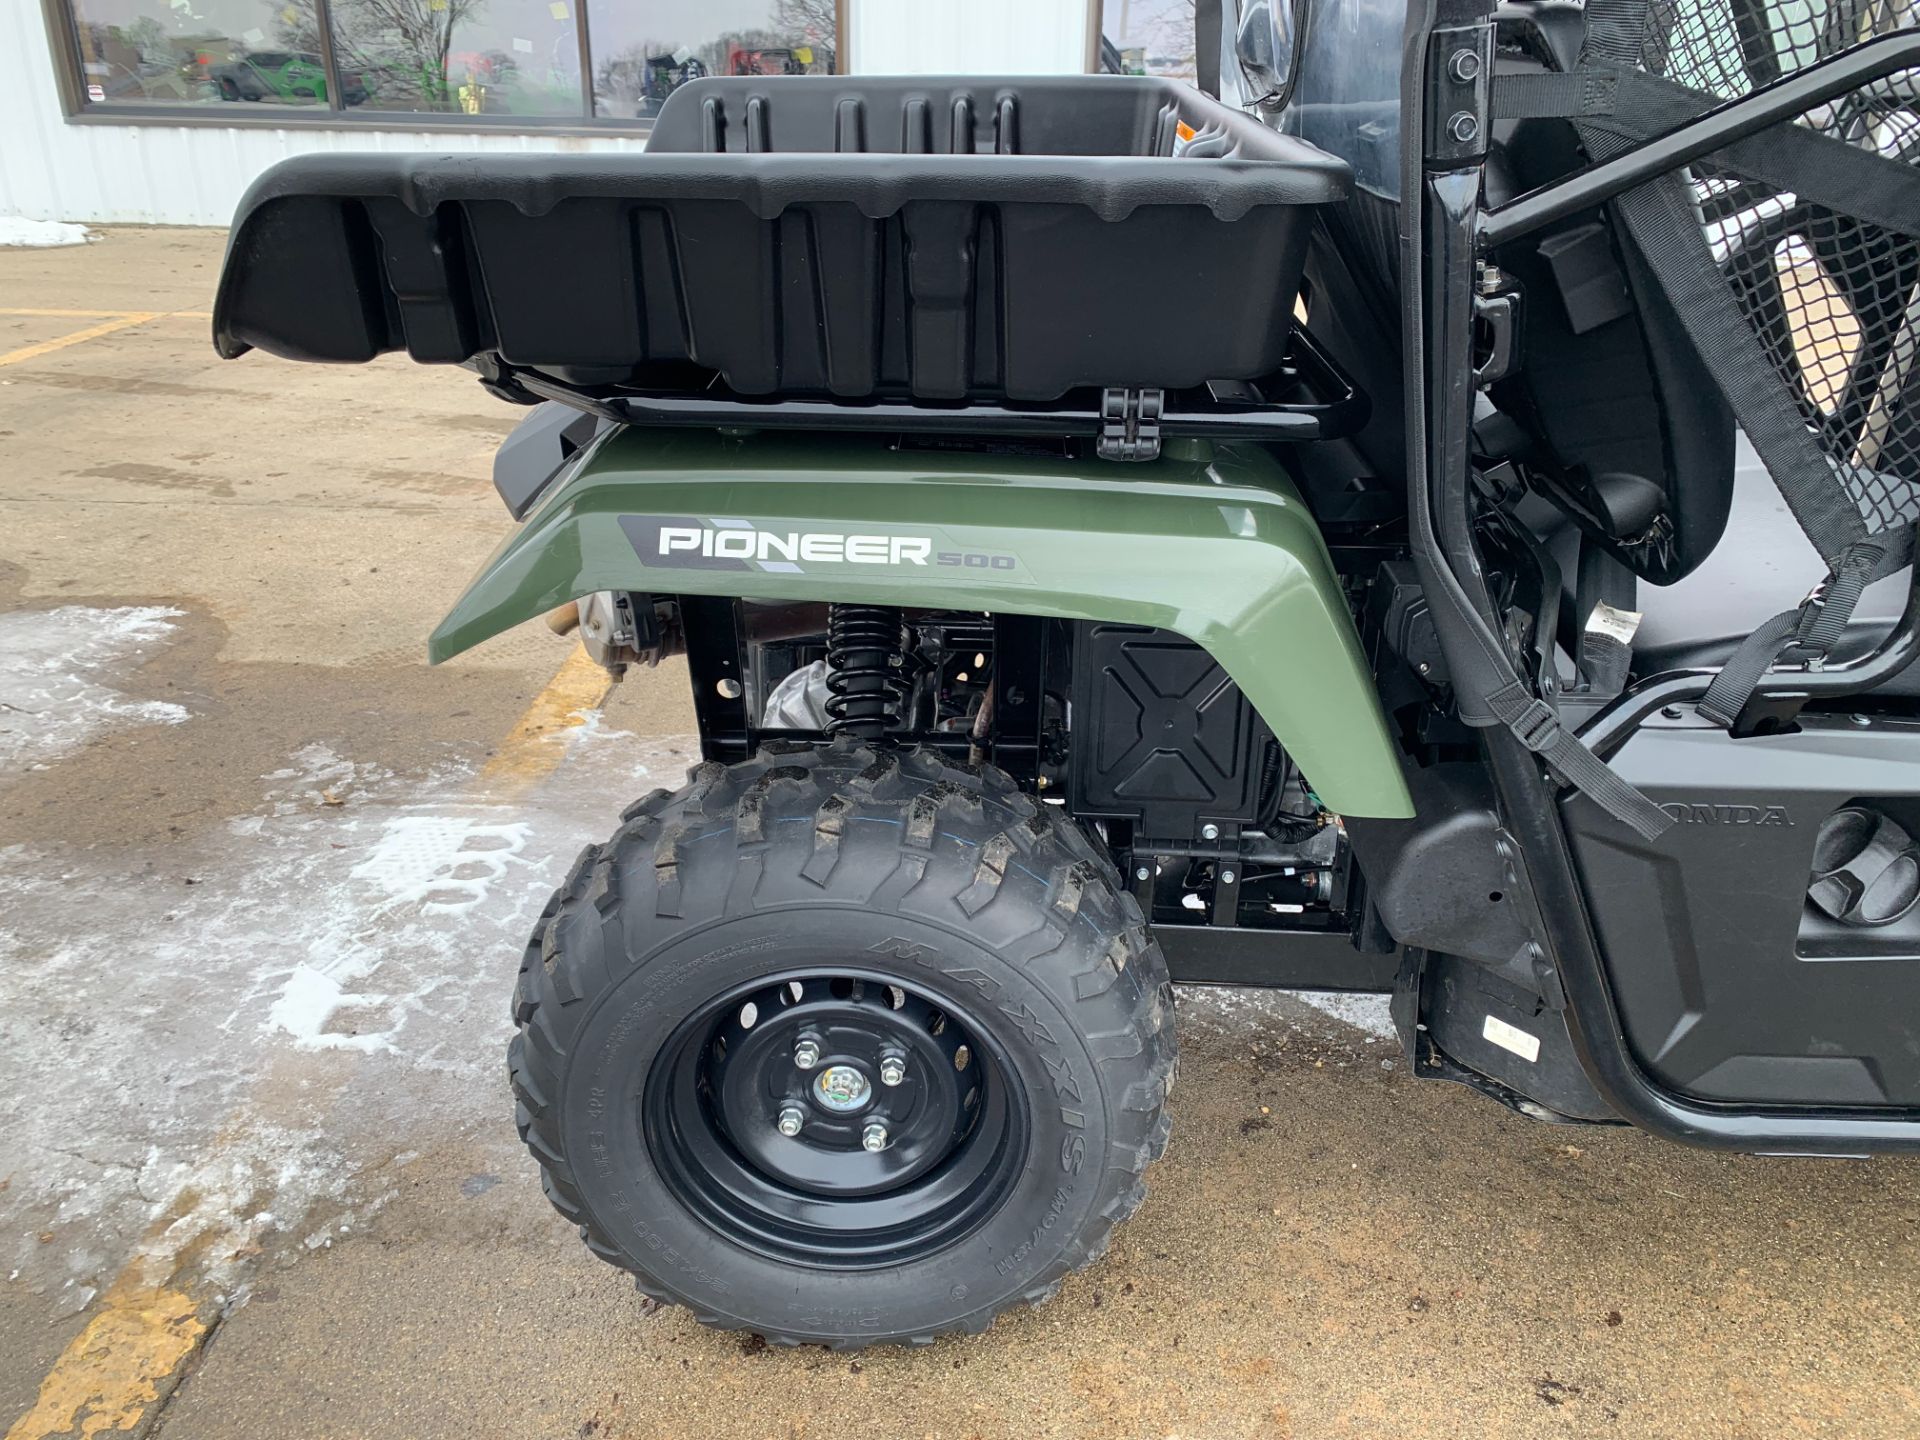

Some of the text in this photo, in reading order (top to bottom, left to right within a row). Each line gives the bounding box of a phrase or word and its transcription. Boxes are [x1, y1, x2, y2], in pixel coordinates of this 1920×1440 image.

[658, 527, 1016, 570] PIONEER 500
[1653, 802, 1796, 825] ONDA
[867, 935, 1087, 1176] MAXXIS
